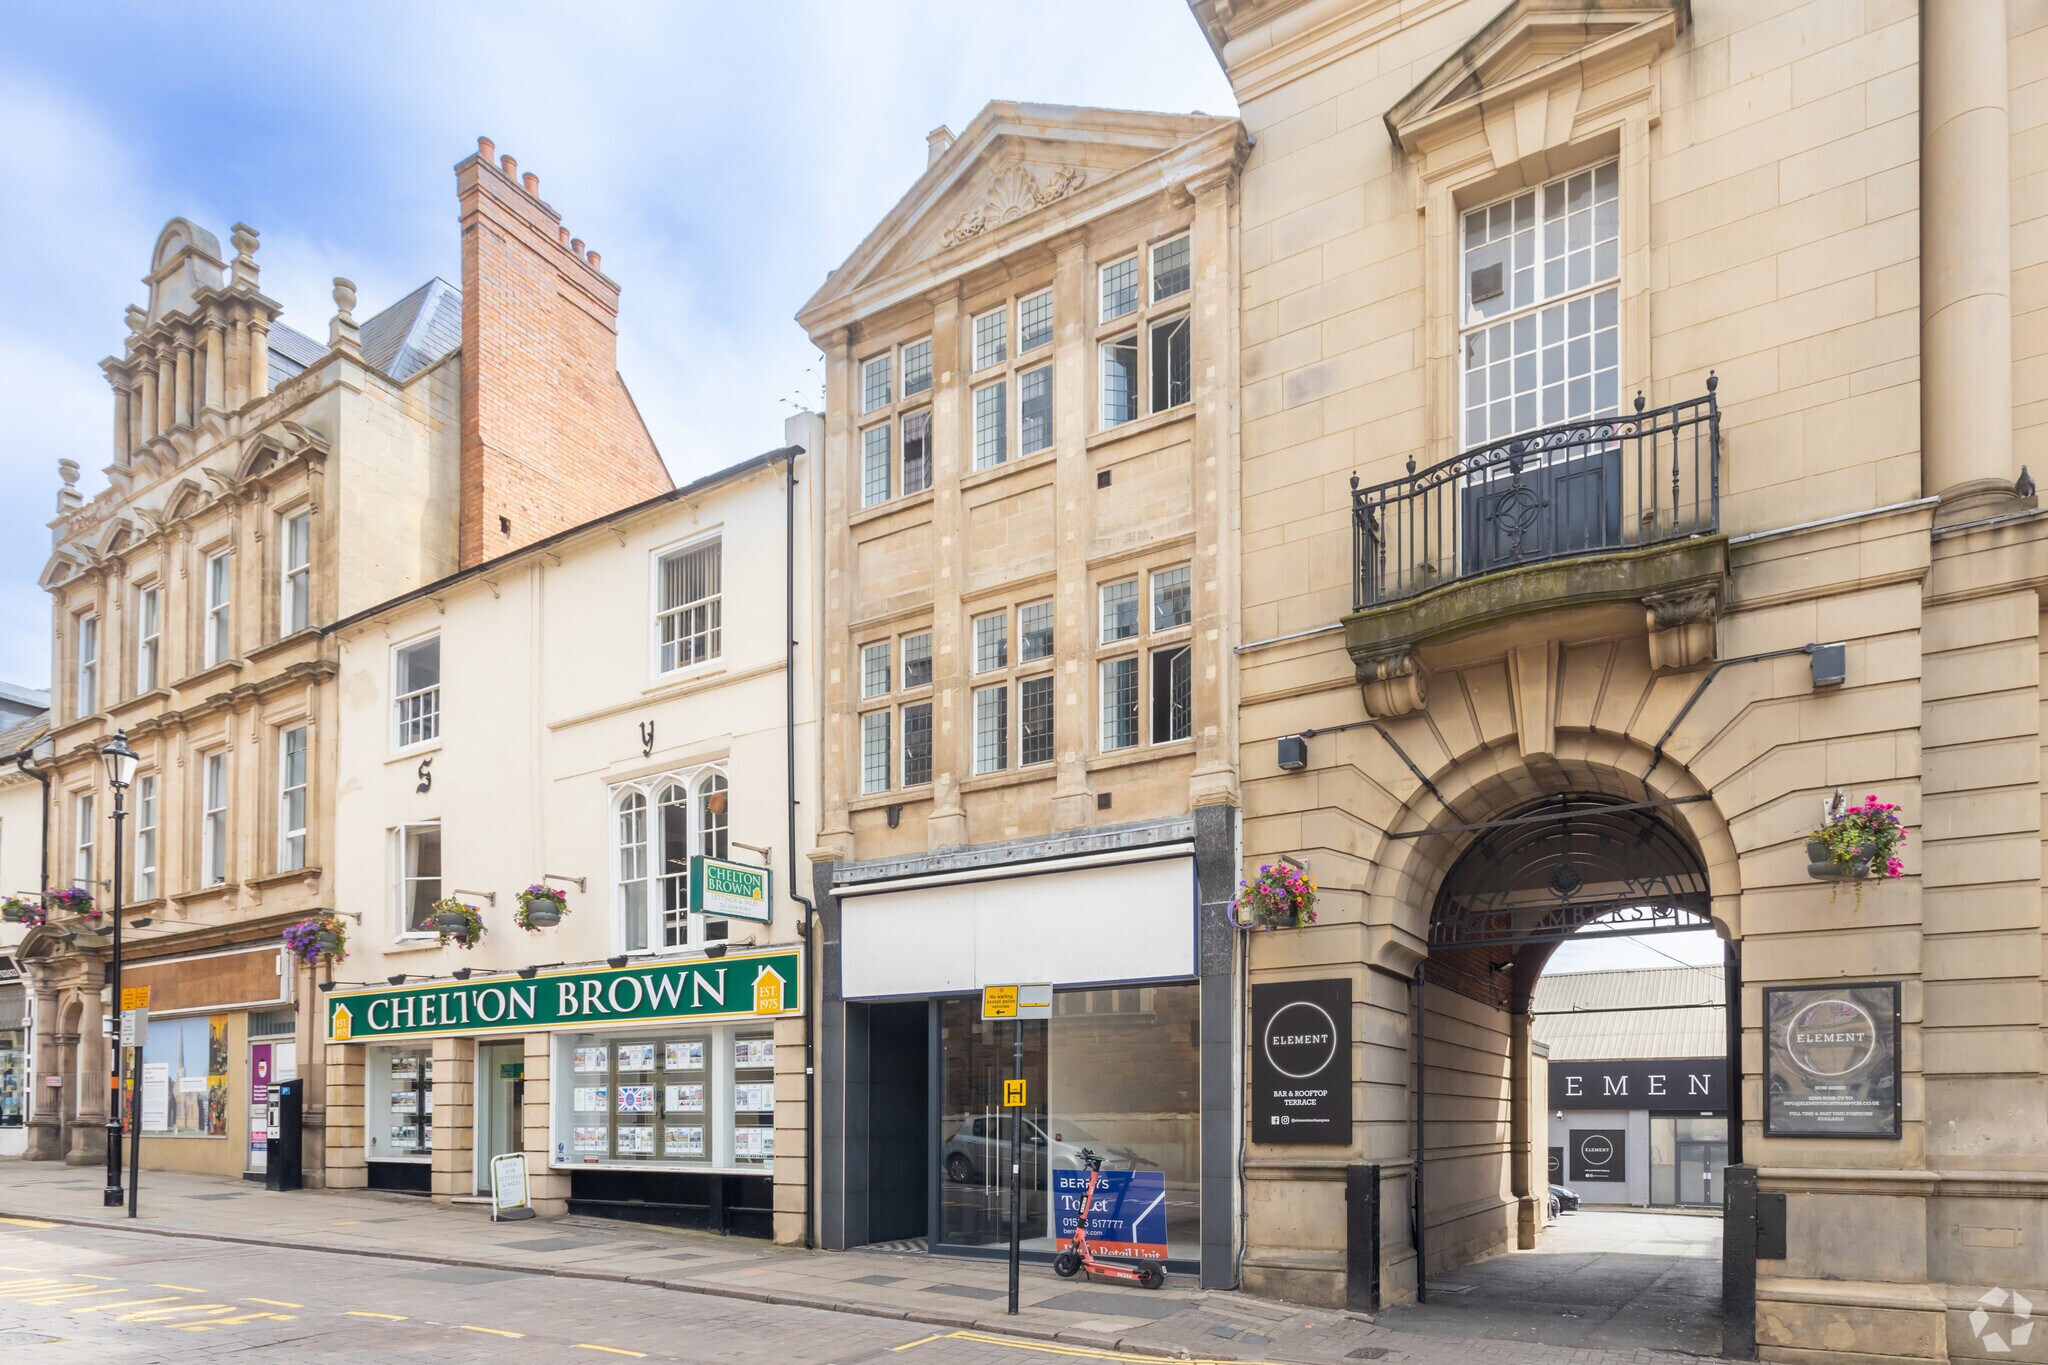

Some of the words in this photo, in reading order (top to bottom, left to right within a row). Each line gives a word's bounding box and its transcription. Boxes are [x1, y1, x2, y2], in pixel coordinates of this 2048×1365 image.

[708, 866, 761, 887] CHELTON
[709, 878, 751, 896] BROWN
[1491, 906, 1643, 930] CHAMBERS
[367, 985, 538, 1031] CHELTON
[556, 968, 728, 1017] BROWN
[760, 986, 778, 997] EST.
[760, 999, 778, 1010] 1975
[1273, 1034, 1329, 1045] ELEMENT
[1797, 1033, 1865, 1043] ELEMENT
[1007, 1083, 1022, 1103] H
[1061, 1195, 1080, 1211] To
[1063, 1218, 1089, 1228] 0156
[1092, 1219, 1124, 1229] 517777
